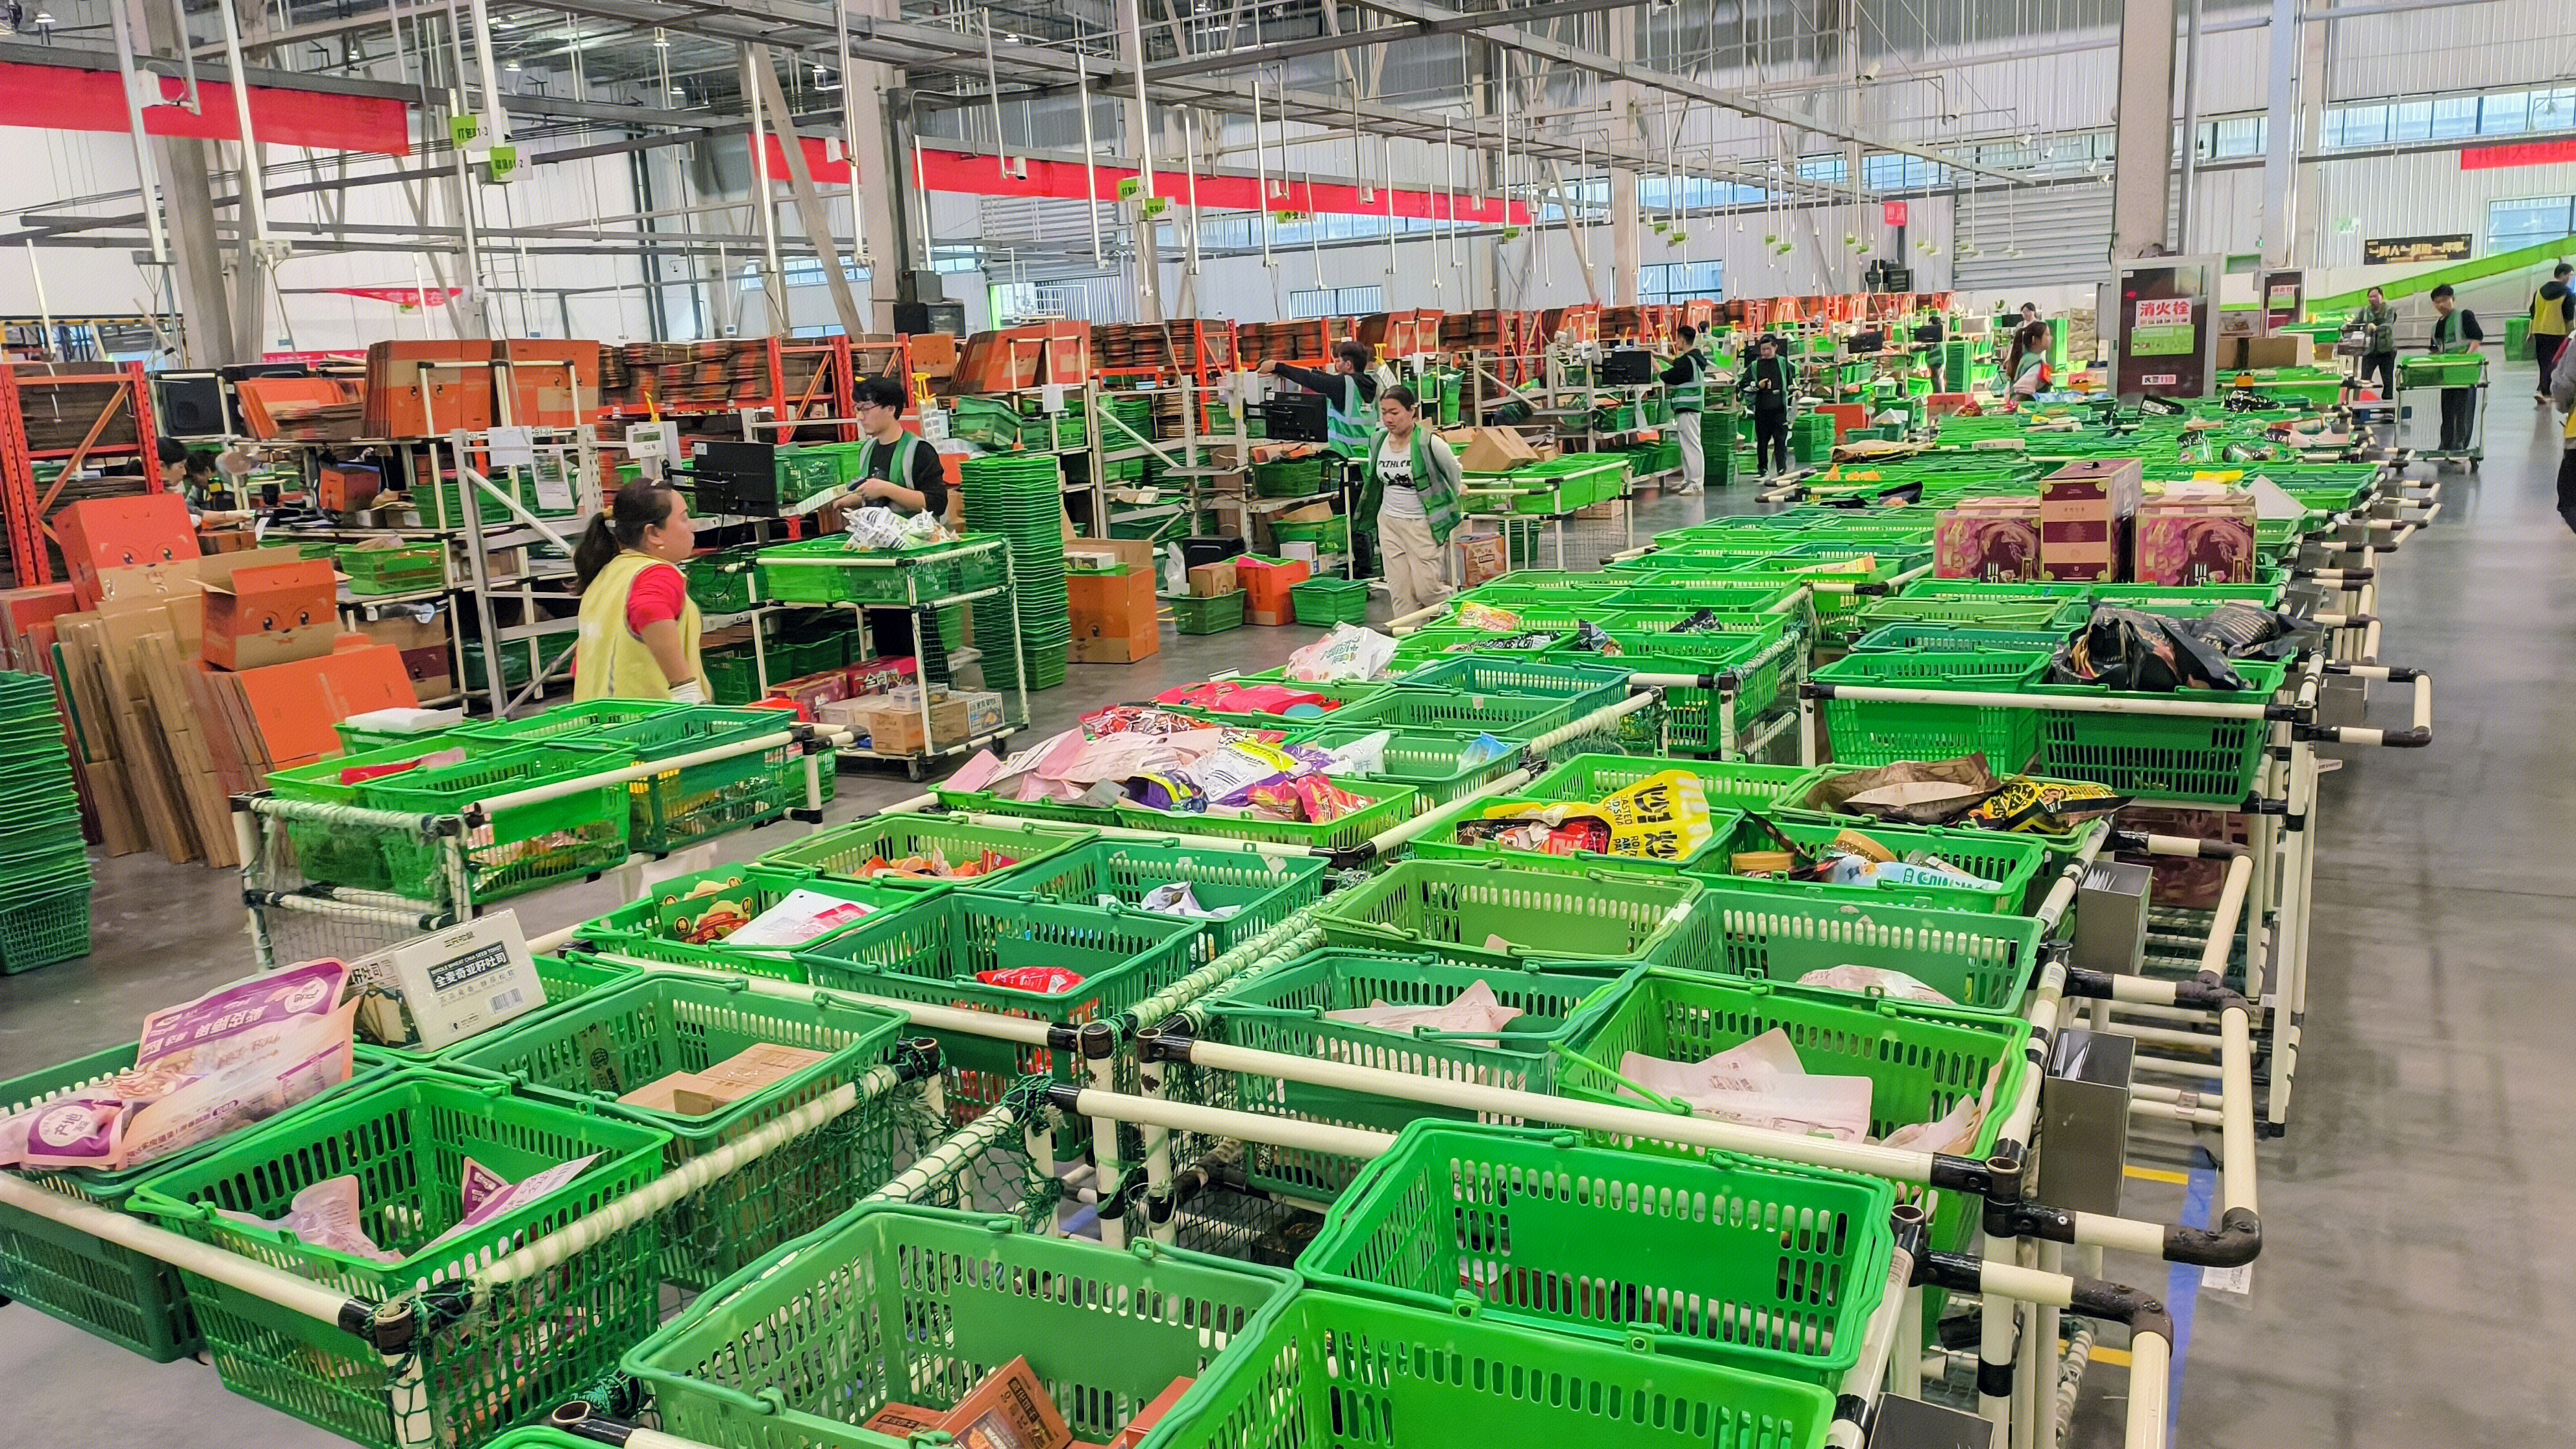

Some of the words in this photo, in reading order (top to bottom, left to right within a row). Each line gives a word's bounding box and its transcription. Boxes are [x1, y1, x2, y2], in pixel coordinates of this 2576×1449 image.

[2140, 301, 2189, 317] 消火栓
[433, 952, 508, 988] 全麦奇亚籽吐司
